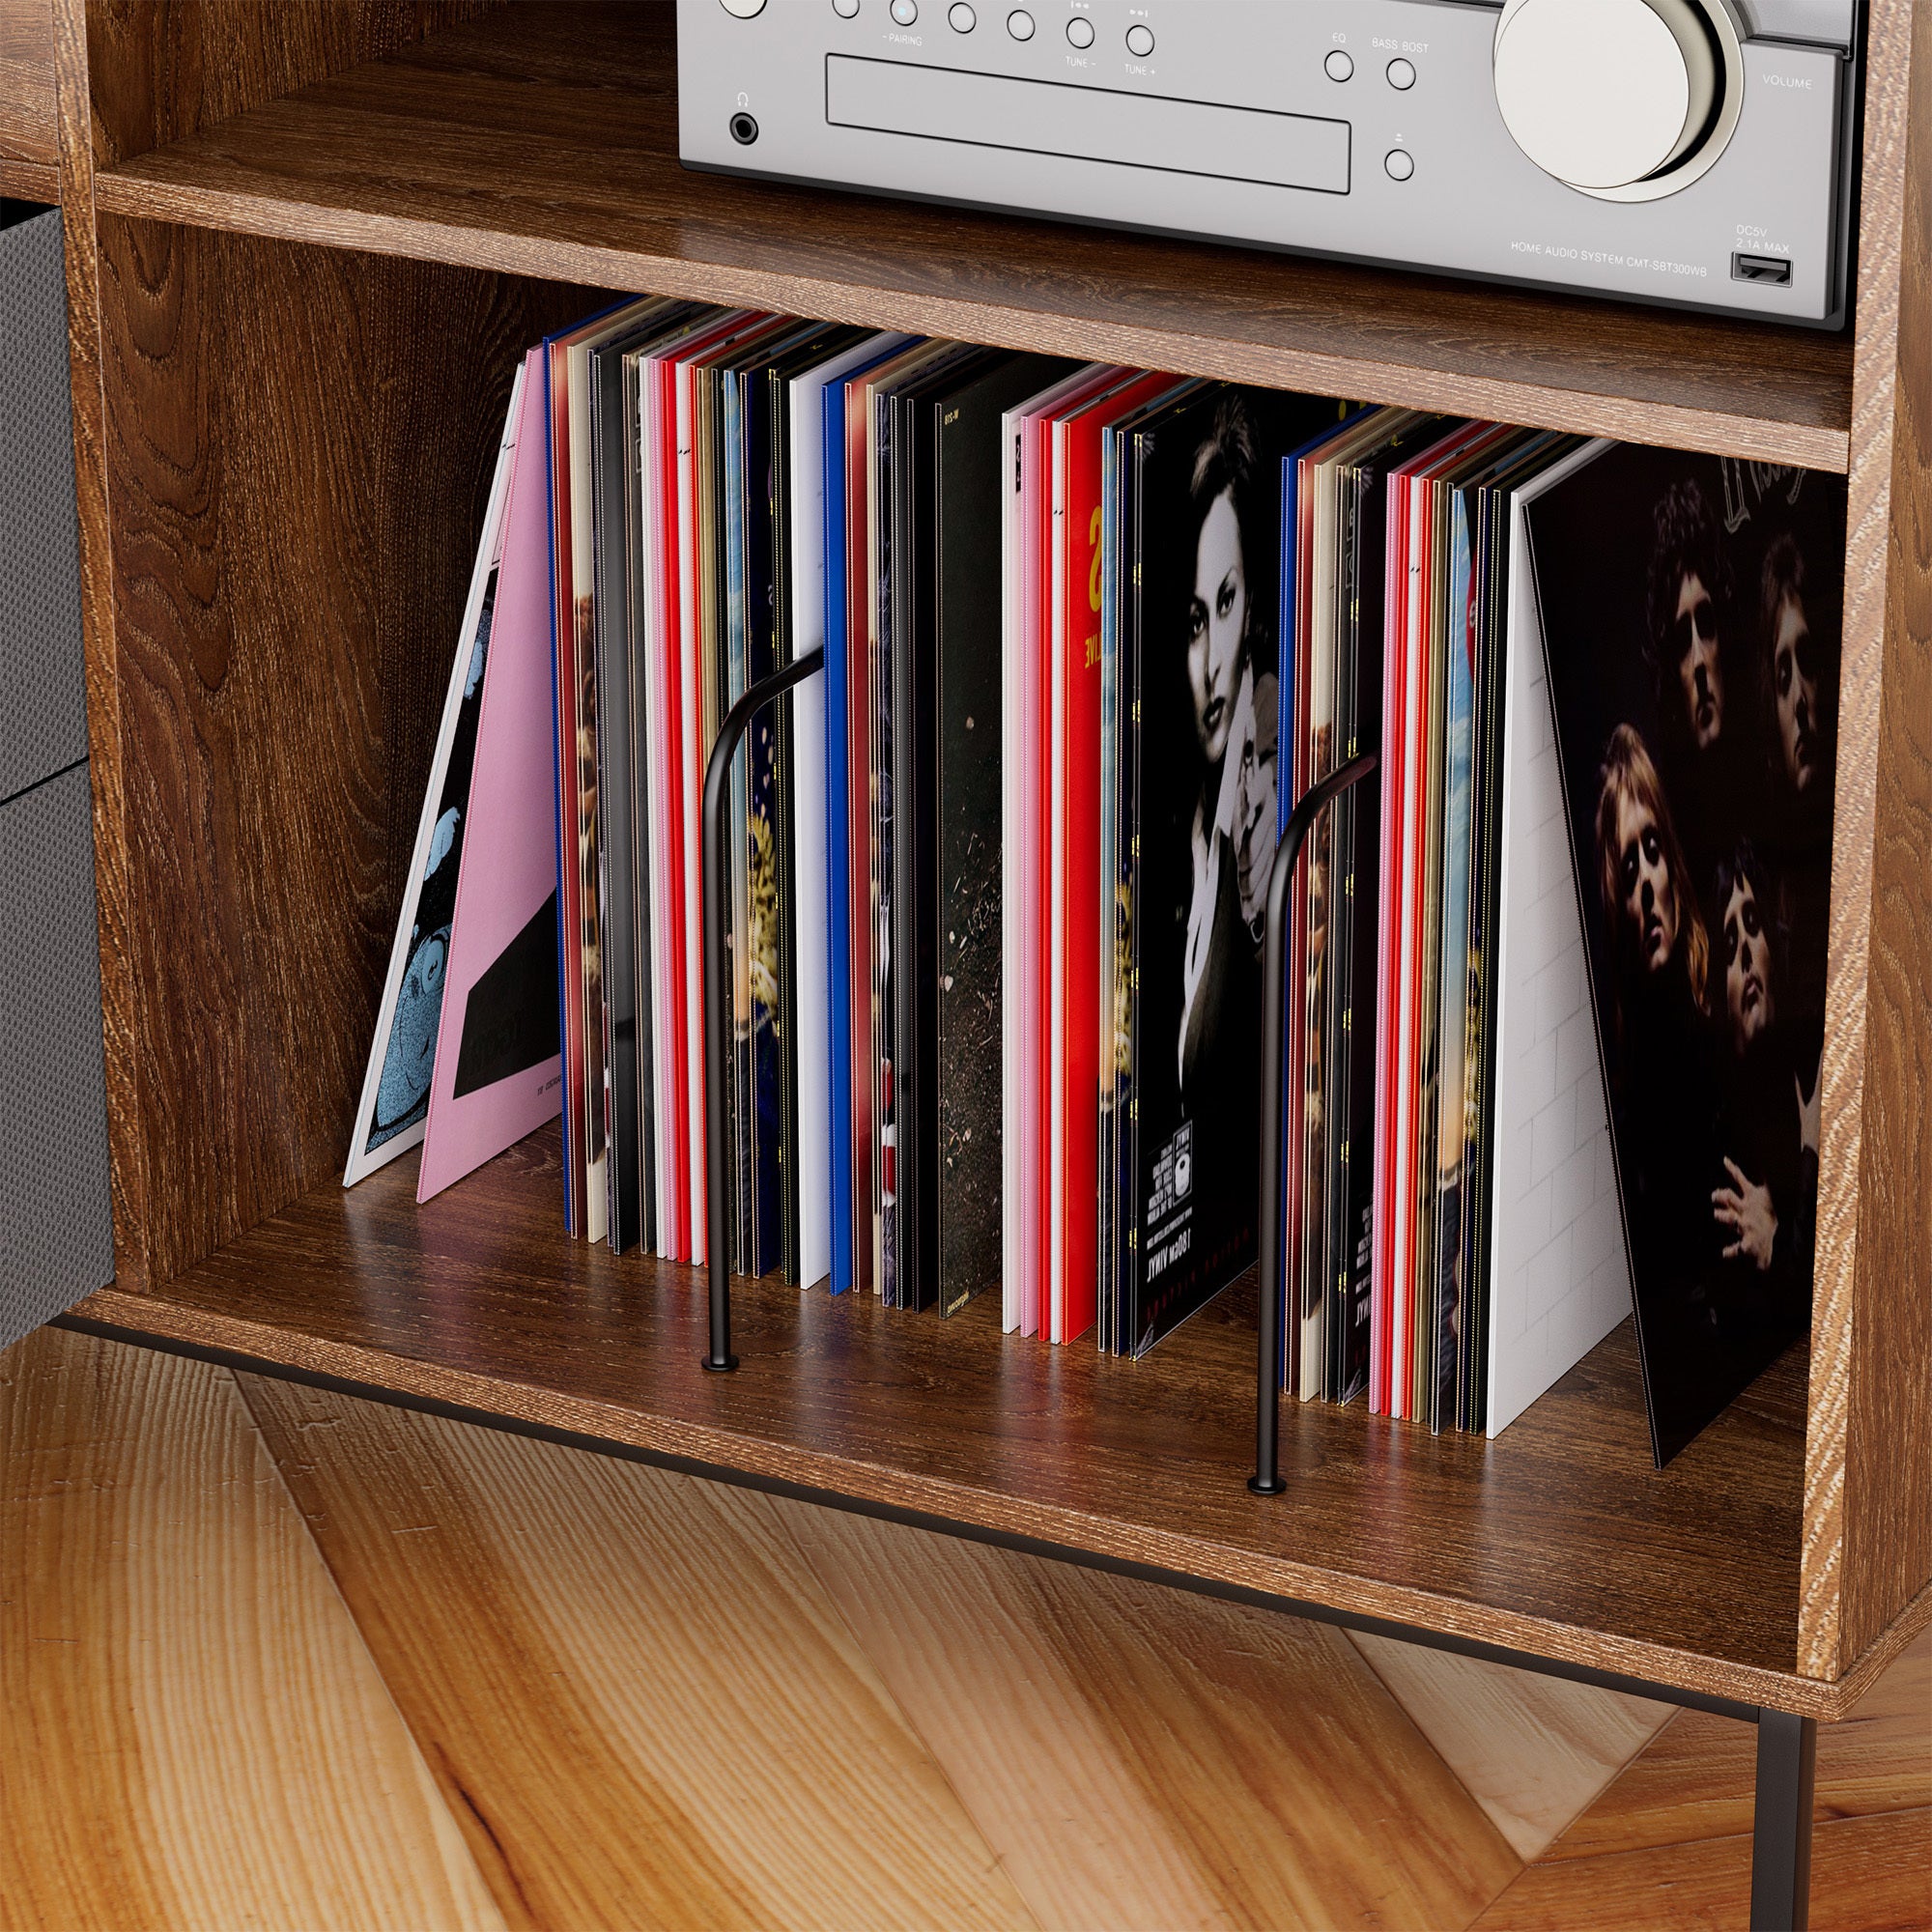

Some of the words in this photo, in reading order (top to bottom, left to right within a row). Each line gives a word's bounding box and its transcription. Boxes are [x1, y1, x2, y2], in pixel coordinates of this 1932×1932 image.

[889, 33, 923, 46] PAIRING
[1332, 32, 1347, 43] EQ
[1372, 37, 1398, 50] BASS
[1402, 41, 1429, 53] BOST
[1065, 56, 1088, 69] TUNE
[1124, 63, 1147, 76] TUNE
[1762, 73, 1813, 90] VOLUME
[1736, 224, 1768, 238] DC5V
[1764, 241, 1790, 254] MAX
[1511, 241, 1542, 254] HOME
[1545, 245, 1577, 259] AUDIO
[1580, 250, 1624, 265] SYSTEM
[1626, 256, 1707, 277] CMT-SBT300WB
